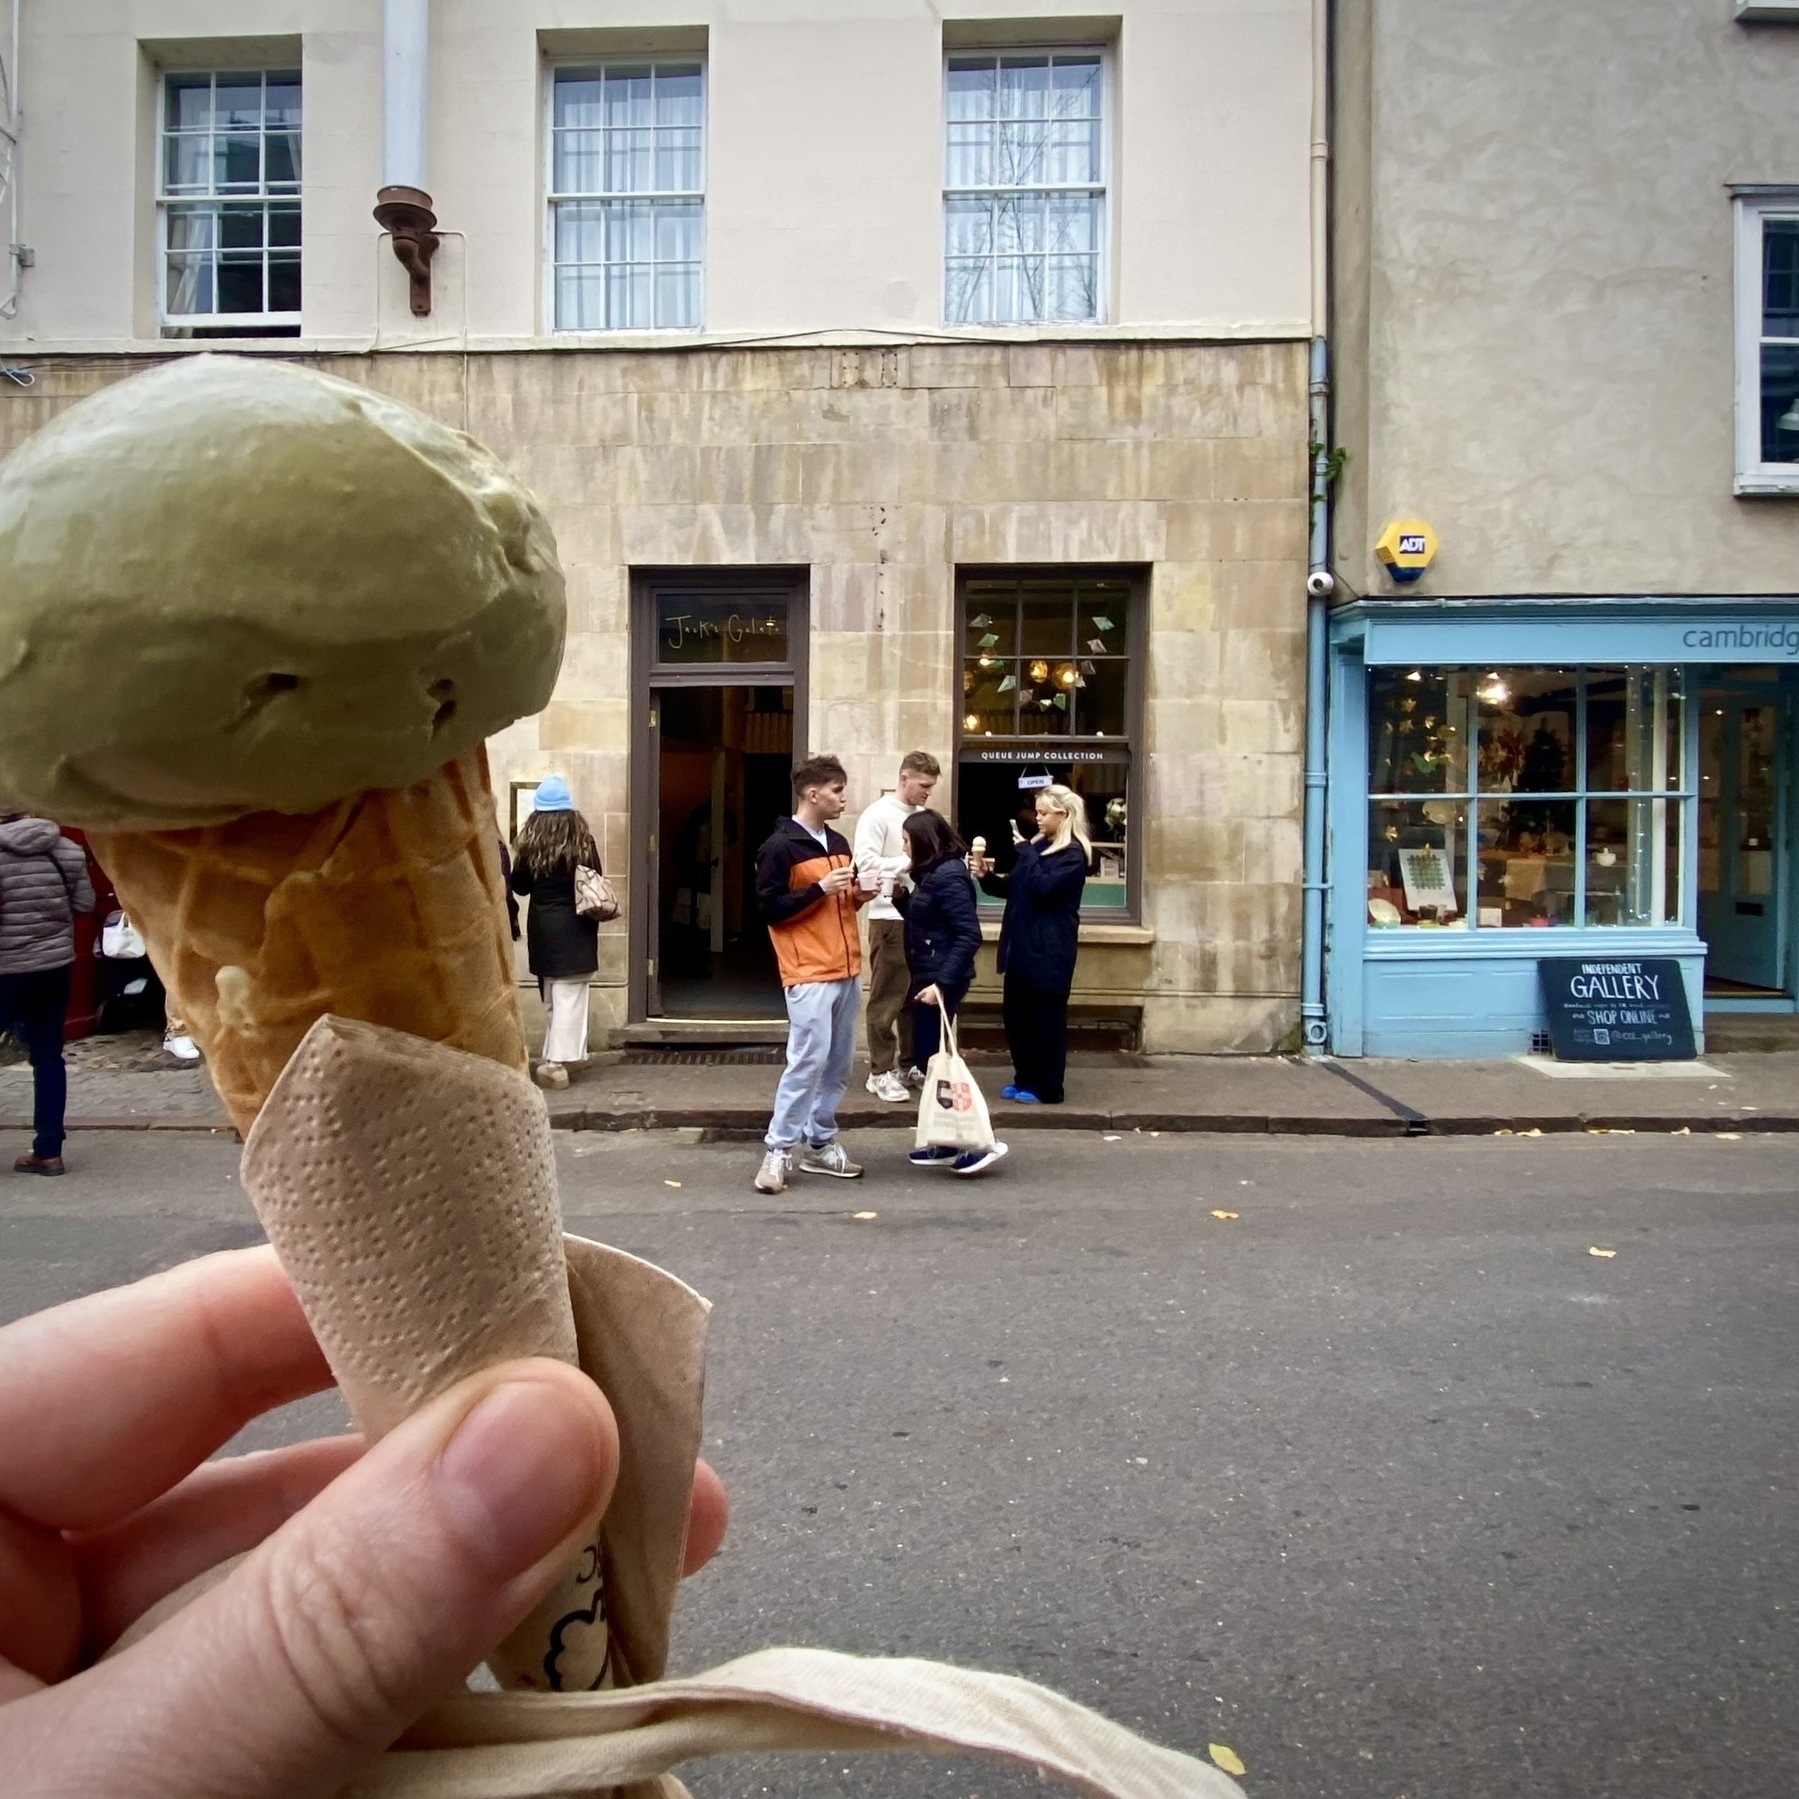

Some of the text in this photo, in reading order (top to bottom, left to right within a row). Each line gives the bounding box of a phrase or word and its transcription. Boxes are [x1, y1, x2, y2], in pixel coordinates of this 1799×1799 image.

[1399, 537, 1426, 552] ADT
[1683, 624, 1799, 655] cambridg
[981, 751, 1103, 760] QUEUE JUMP COLLECTION
[1027, 778, 1045, 786] OPEN
[1582, 963, 1641, 974] INDEPENDENT
[1570, 975, 1659, 1000] GALLERY
[1587, 1010, 1658, 1025] SHOP ONLINE
